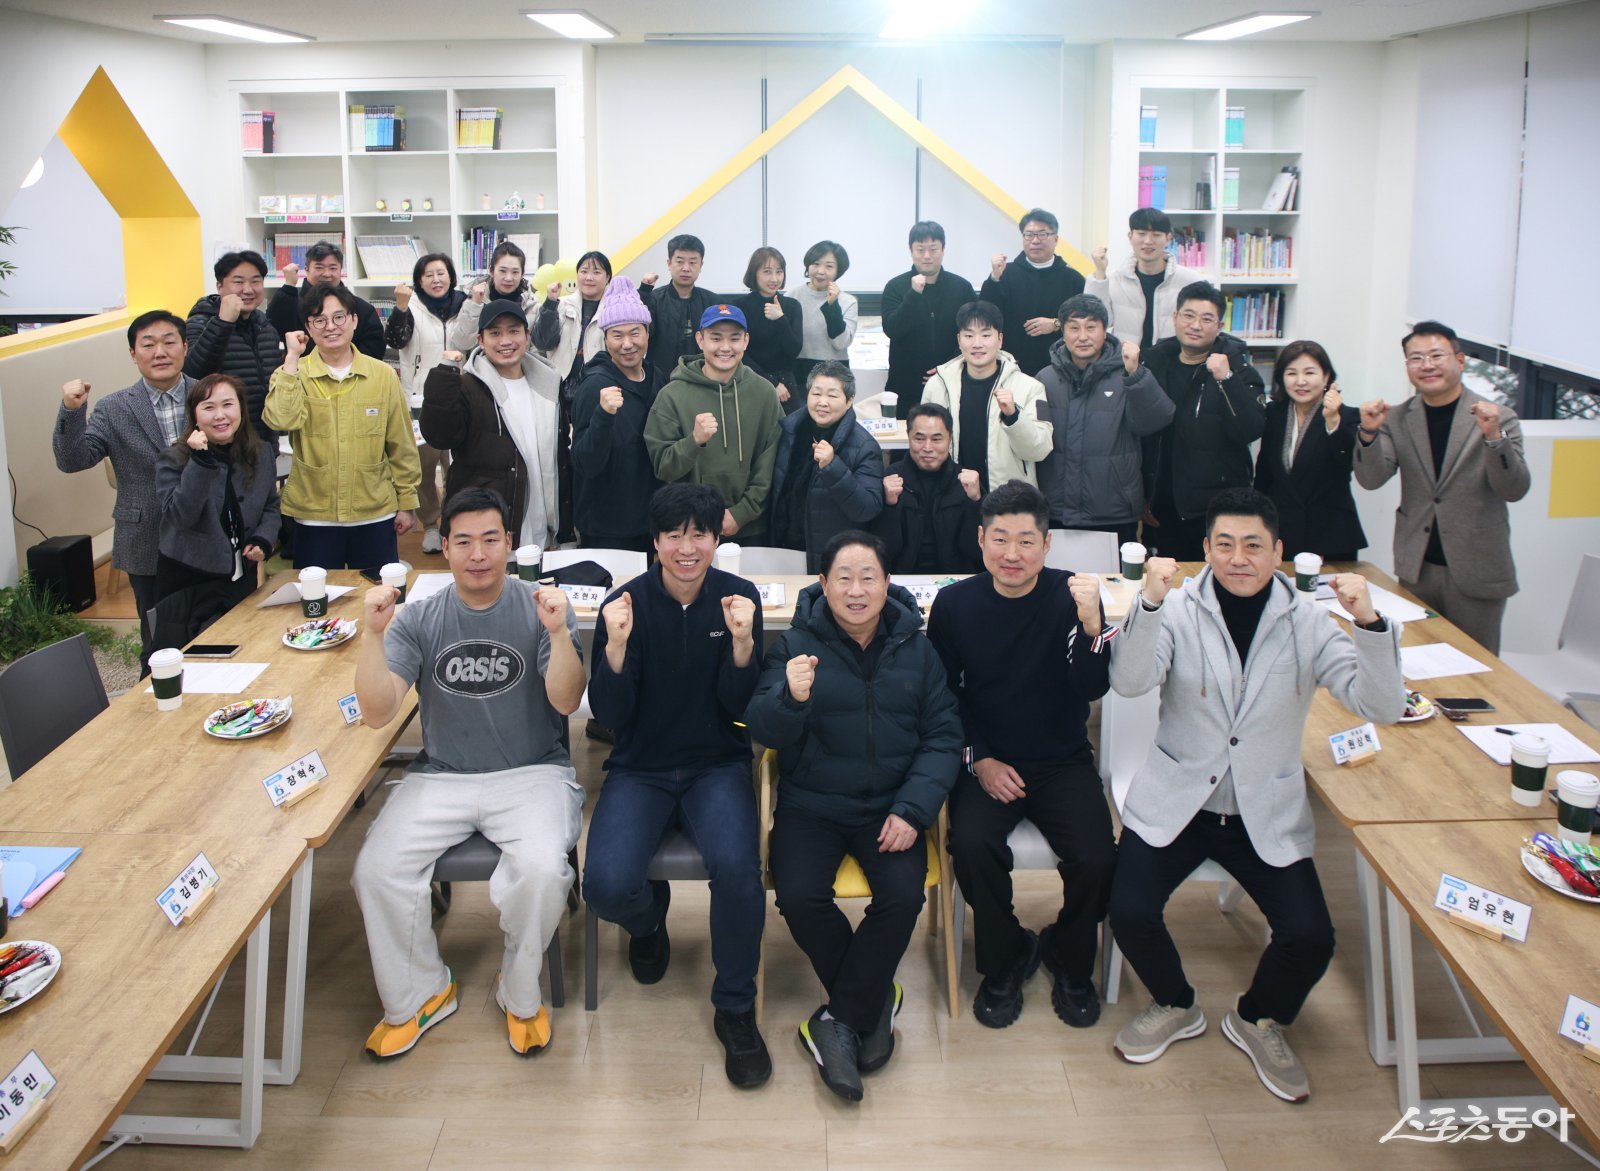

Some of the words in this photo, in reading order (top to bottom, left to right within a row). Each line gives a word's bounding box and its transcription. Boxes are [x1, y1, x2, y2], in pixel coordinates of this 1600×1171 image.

[445, 648, 511, 683] oasis
[179, 867, 208, 900] 김병기
[1468, 896, 1515, 926] 엄유현
[0, 1072, 39, 1120] 이동민
